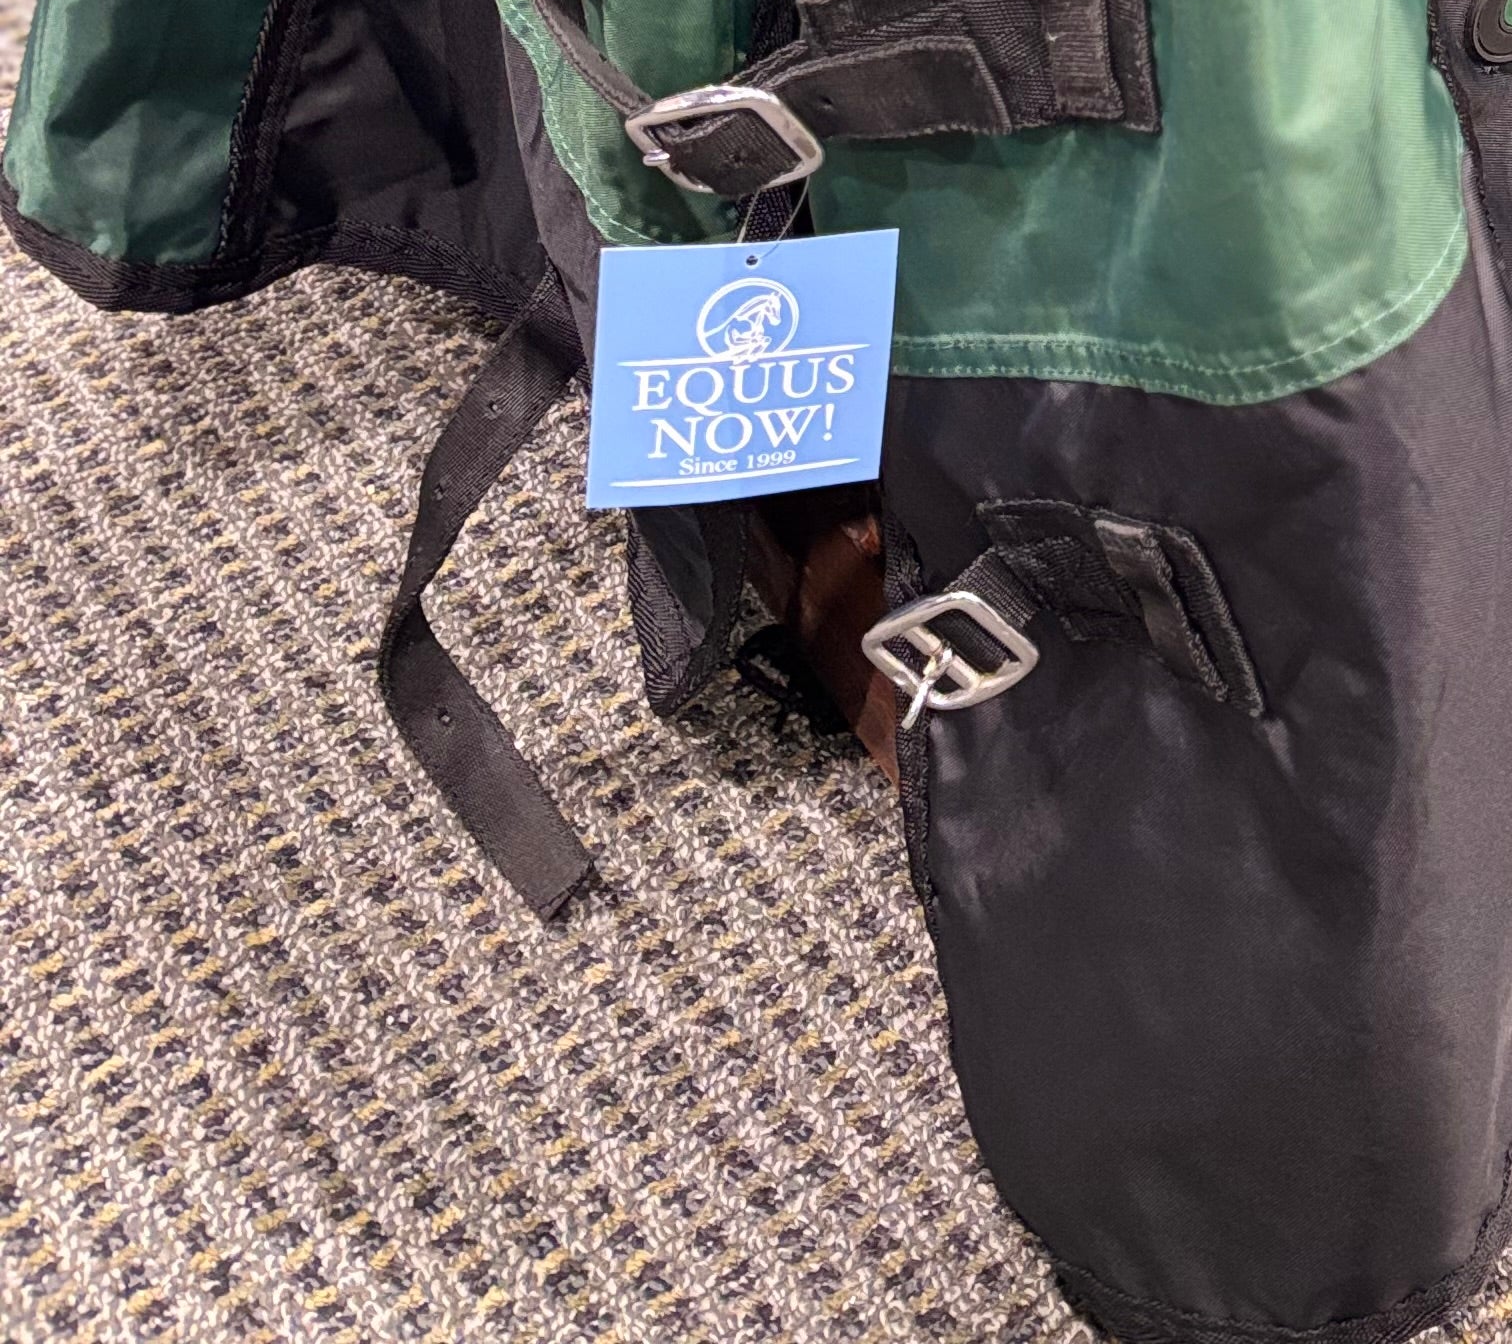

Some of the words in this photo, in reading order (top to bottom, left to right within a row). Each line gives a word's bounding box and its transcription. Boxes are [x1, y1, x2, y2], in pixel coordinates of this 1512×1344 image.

[631, 354, 855, 417] EQUUS
[647, 403, 836, 460] NOW!
[679, 457, 738, 476] Since
[747, 449, 797, 469] 1999
